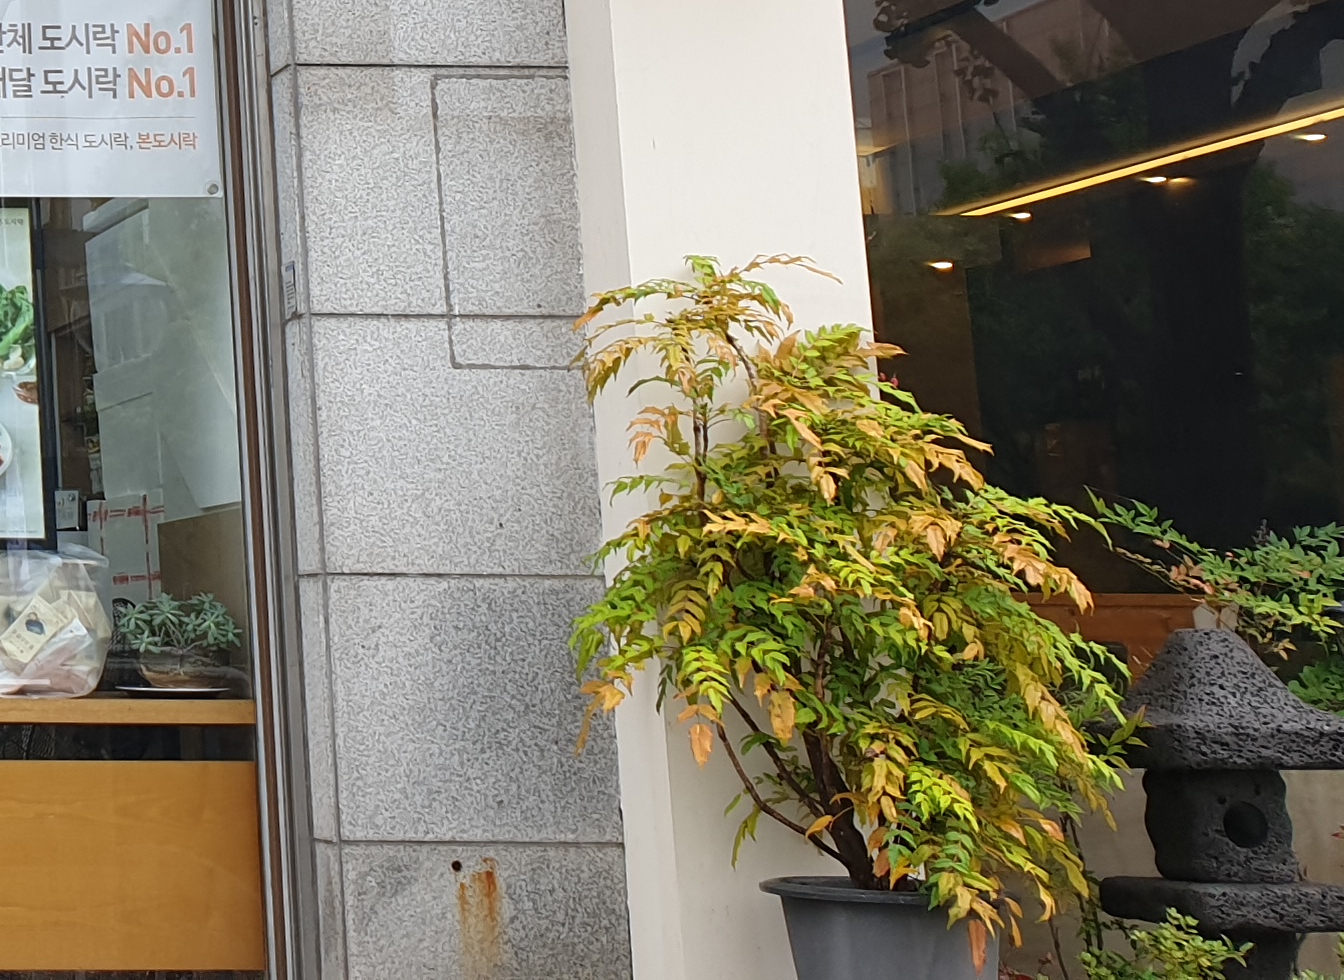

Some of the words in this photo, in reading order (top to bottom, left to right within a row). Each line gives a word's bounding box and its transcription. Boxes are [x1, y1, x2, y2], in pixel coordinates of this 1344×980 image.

[37, 21, 121, 57] 도시락
[126, 21, 195, 56] No.1
[39, 67, 122, 101] 도시락
[127, 66, 197, 100] No.1
[49, 131, 80, 151] 한식
[81, 131, 134, 152] 도시락,
[135, 131, 198, 151] 본도시락
